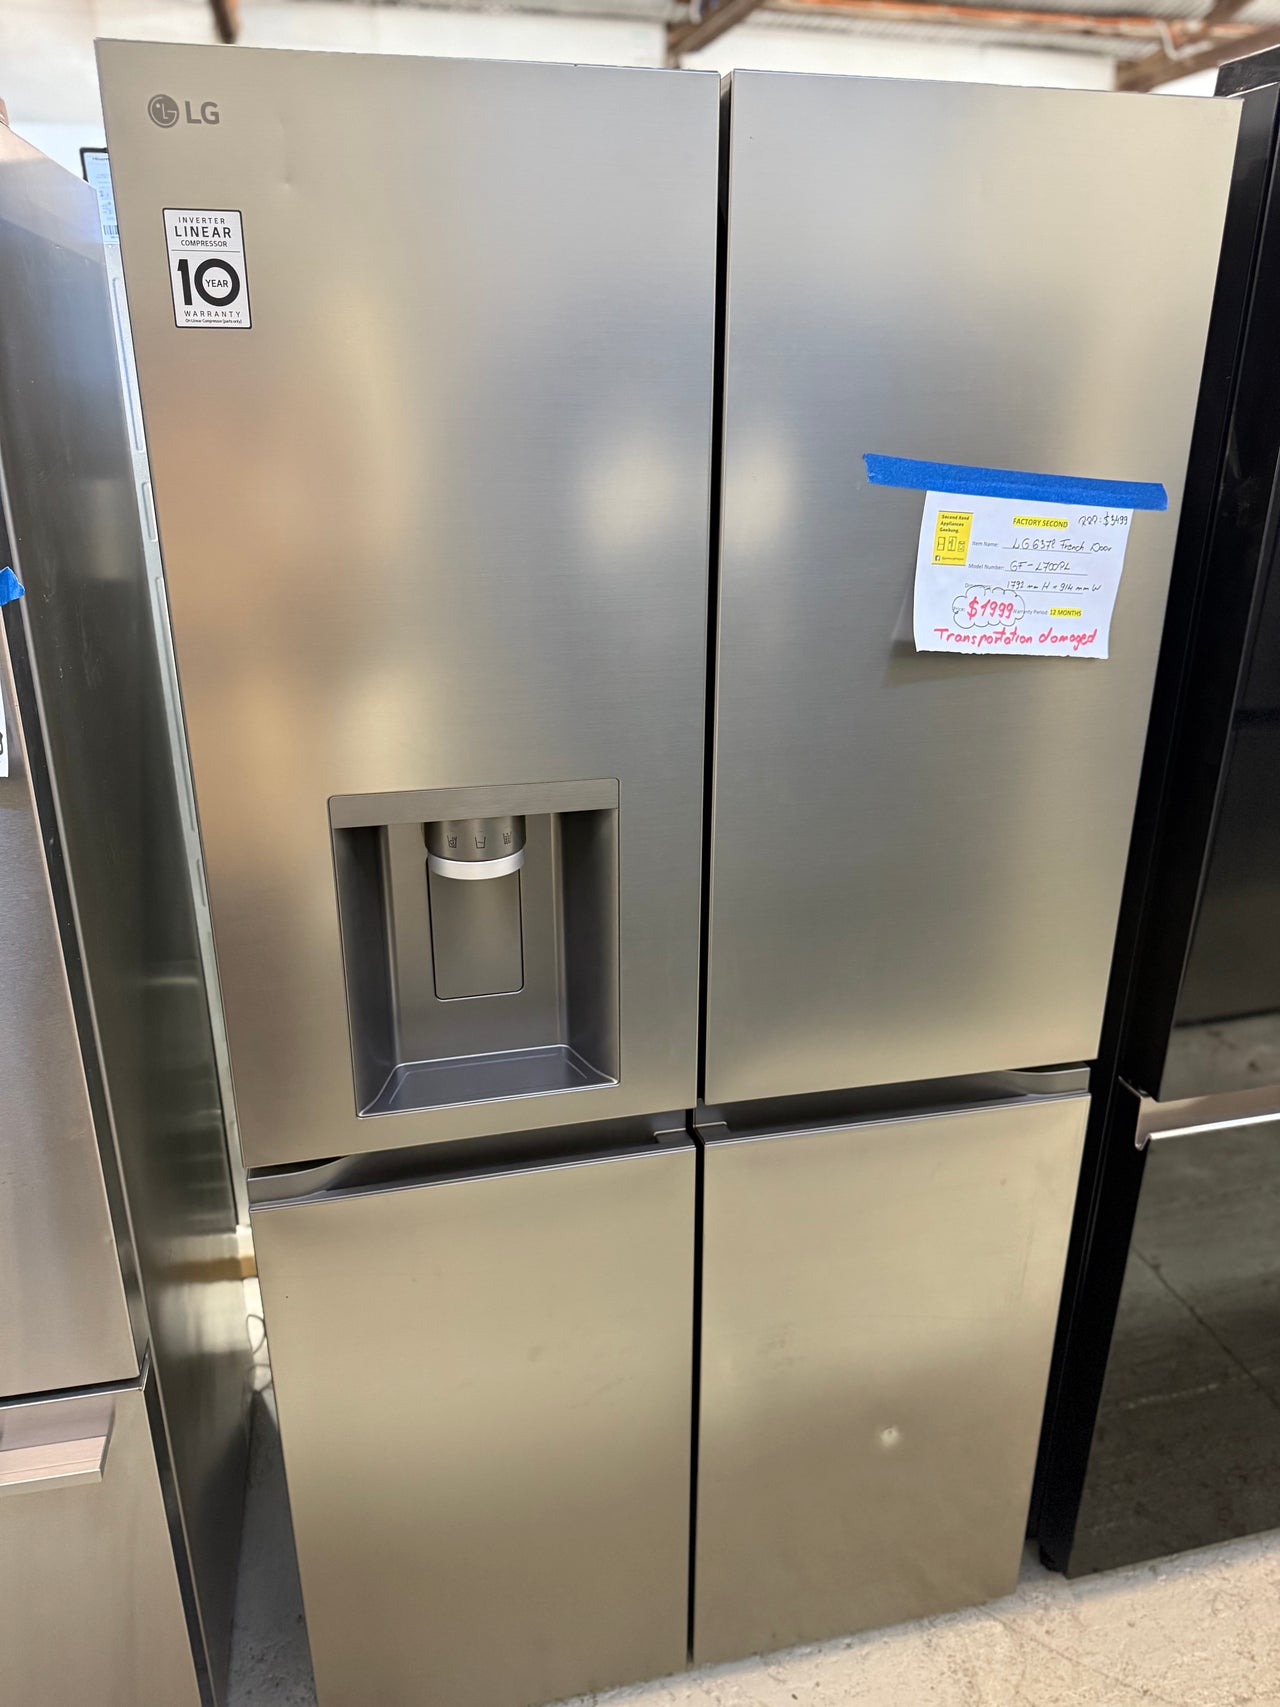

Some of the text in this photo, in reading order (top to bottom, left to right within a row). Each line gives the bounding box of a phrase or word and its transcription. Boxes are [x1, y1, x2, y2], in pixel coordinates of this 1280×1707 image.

[185, 101, 220, 125] LG
[178, 216, 226, 225] INVERTER
[174, 225, 232, 239] LINEAR
[180, 240, 228, 248] COMPRESSOR
[177, 258, 240, 307] 10
[205, 279, 229, 288] YEAR
[184, 310, 241, 318] WARRANTY
[1012, 517, 1069, 528] FACTORY SECOND
[966, 596, 1014, 620] $1999
[934, 626, 1098, 651] Transportation damaged
